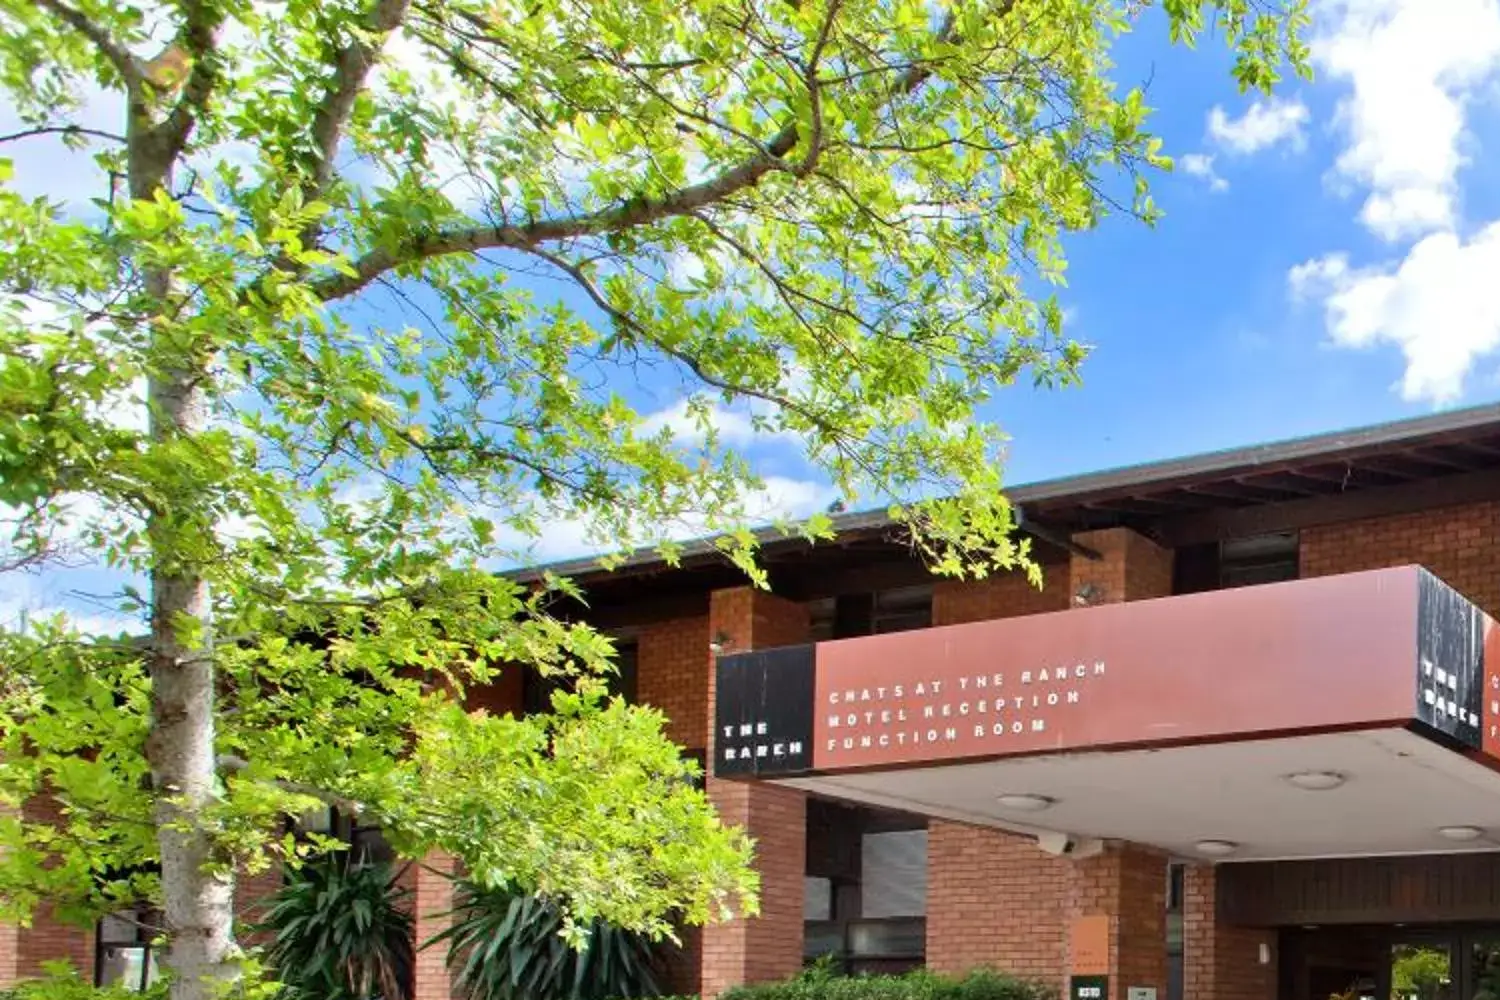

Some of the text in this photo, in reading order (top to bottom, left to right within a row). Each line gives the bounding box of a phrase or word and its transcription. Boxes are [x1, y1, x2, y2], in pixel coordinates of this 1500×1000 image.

[829, 661, 1107, 704] CHATS AT THE RANCH
[828, 691, 1080, 728] MOTEL RECEPTION
[723, 721, 768, 738] THE
[827, 718, 1046, 752] FUNCTION ROOM
[724, 741, 803, 761] RANCH
